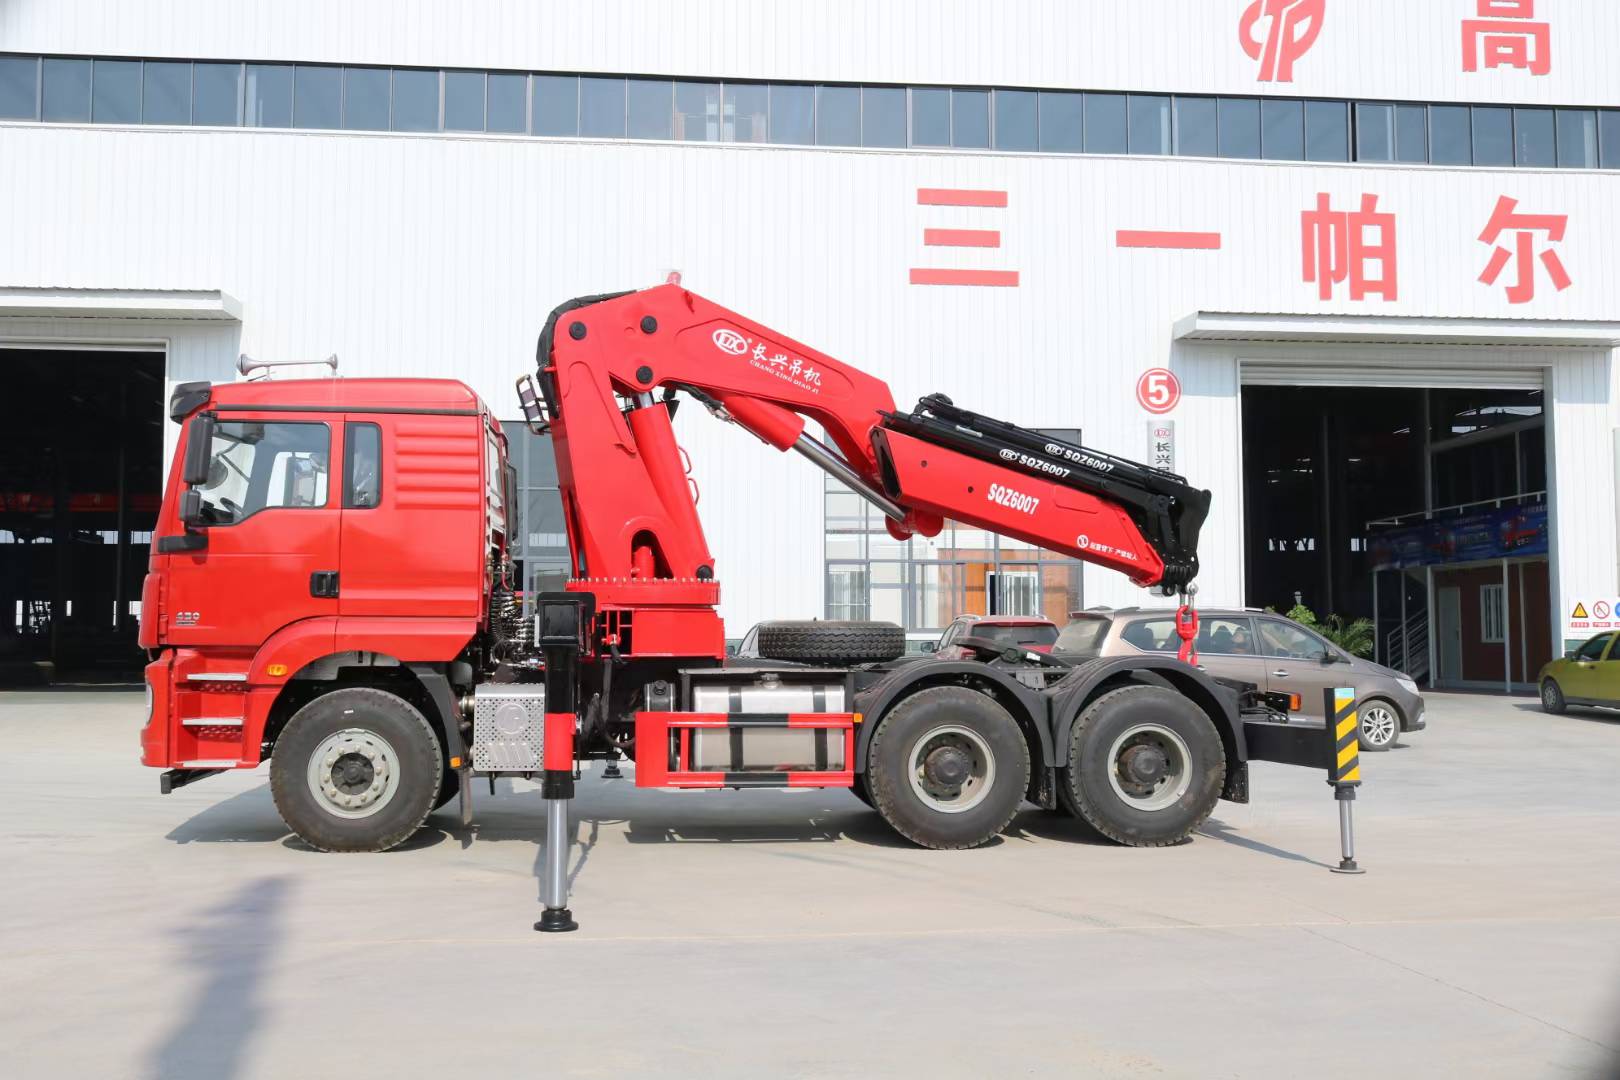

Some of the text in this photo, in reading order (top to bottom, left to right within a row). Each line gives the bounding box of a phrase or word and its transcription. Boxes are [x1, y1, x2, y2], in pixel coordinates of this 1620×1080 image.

[1461, 0, 1551, 76] 高
[909, 188, 1572, 304] 三一帕尔
[749, 359, 775, 374] CHANG
[775, 371, 793, 382] XING
[793, 379, 811, 390] DIAO
[752, 343, 822, 386] 长兴吊机
[1148, 374, 1170, 405] 5
[1019, 454, 1070, 478] SQZ6007
[1063, 449, 1114, 472] SQZ6007
[987, 483, 1040, 515] SQZ6007
